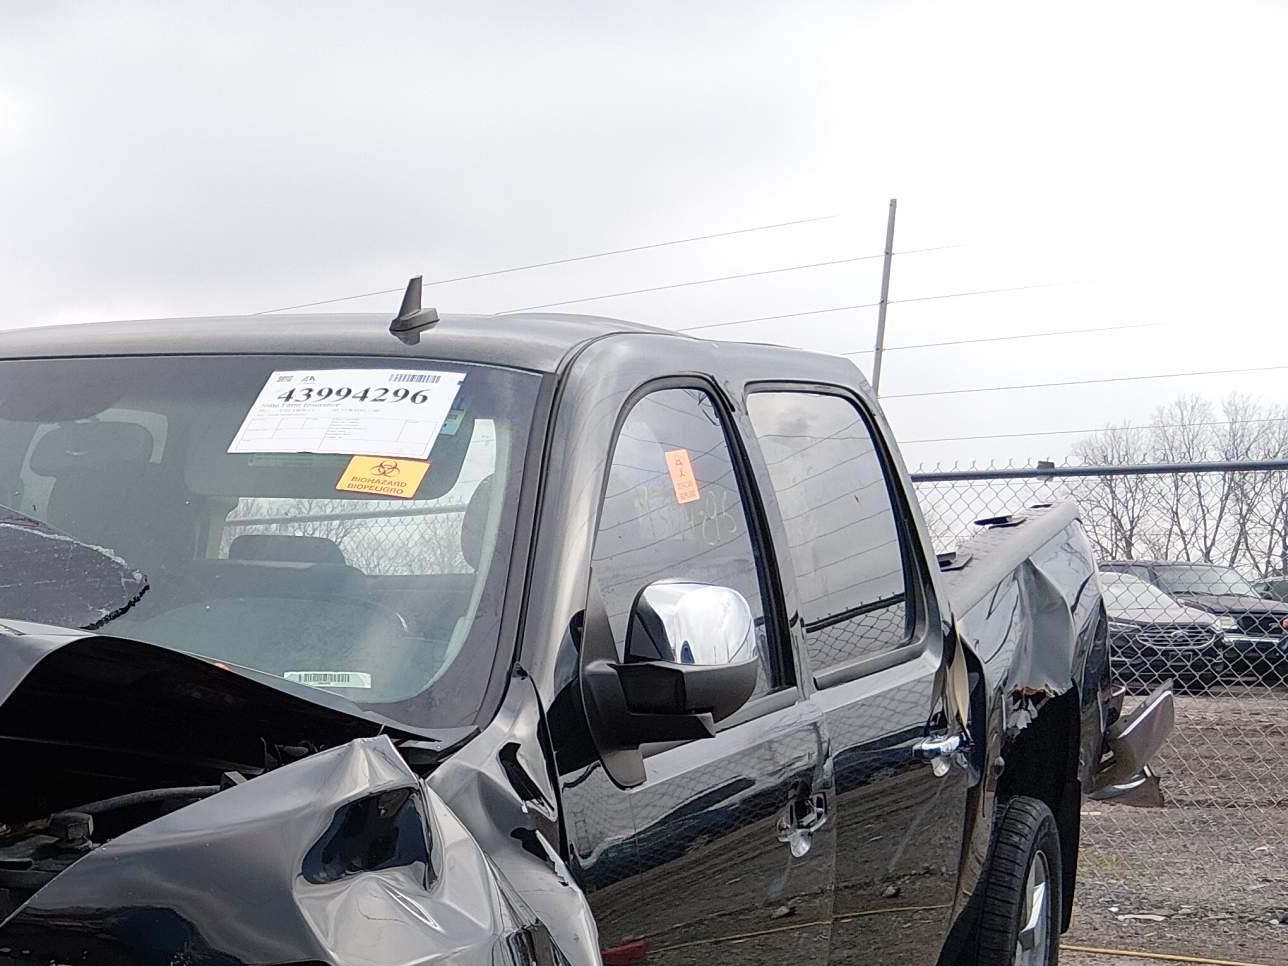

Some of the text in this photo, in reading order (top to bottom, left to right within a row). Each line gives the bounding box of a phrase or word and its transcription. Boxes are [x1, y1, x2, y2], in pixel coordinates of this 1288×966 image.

[277, 387, 432, 405] 43994296
[346, 482, 404, 495] BIOPELIGRO
[350, 476, 408, 488] BIOHAZARD
